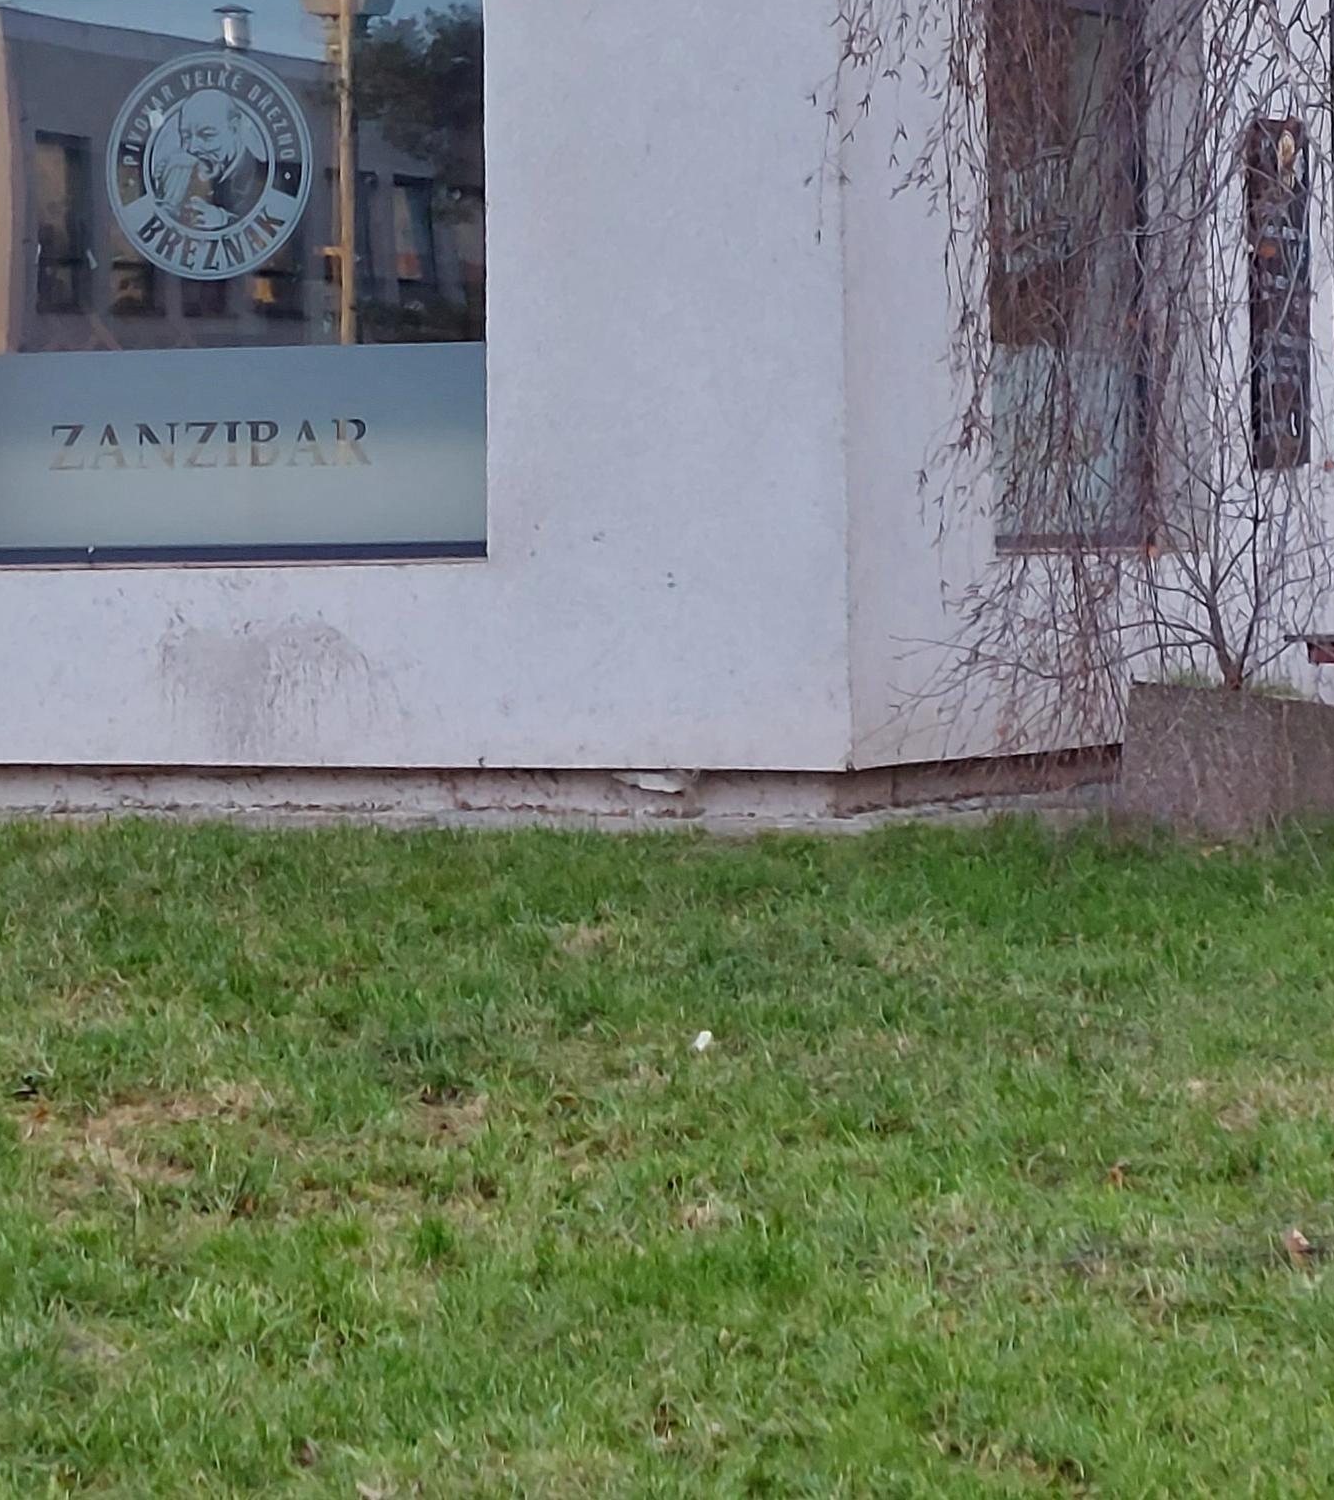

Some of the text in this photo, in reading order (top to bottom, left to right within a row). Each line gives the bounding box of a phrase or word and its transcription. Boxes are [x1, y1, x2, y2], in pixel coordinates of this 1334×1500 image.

[122, 84, 175, 168] PIVOVAR
[181, 69, 243, 92] VELKÉ
[49, 417, 373, 471] ZANZIBAR
